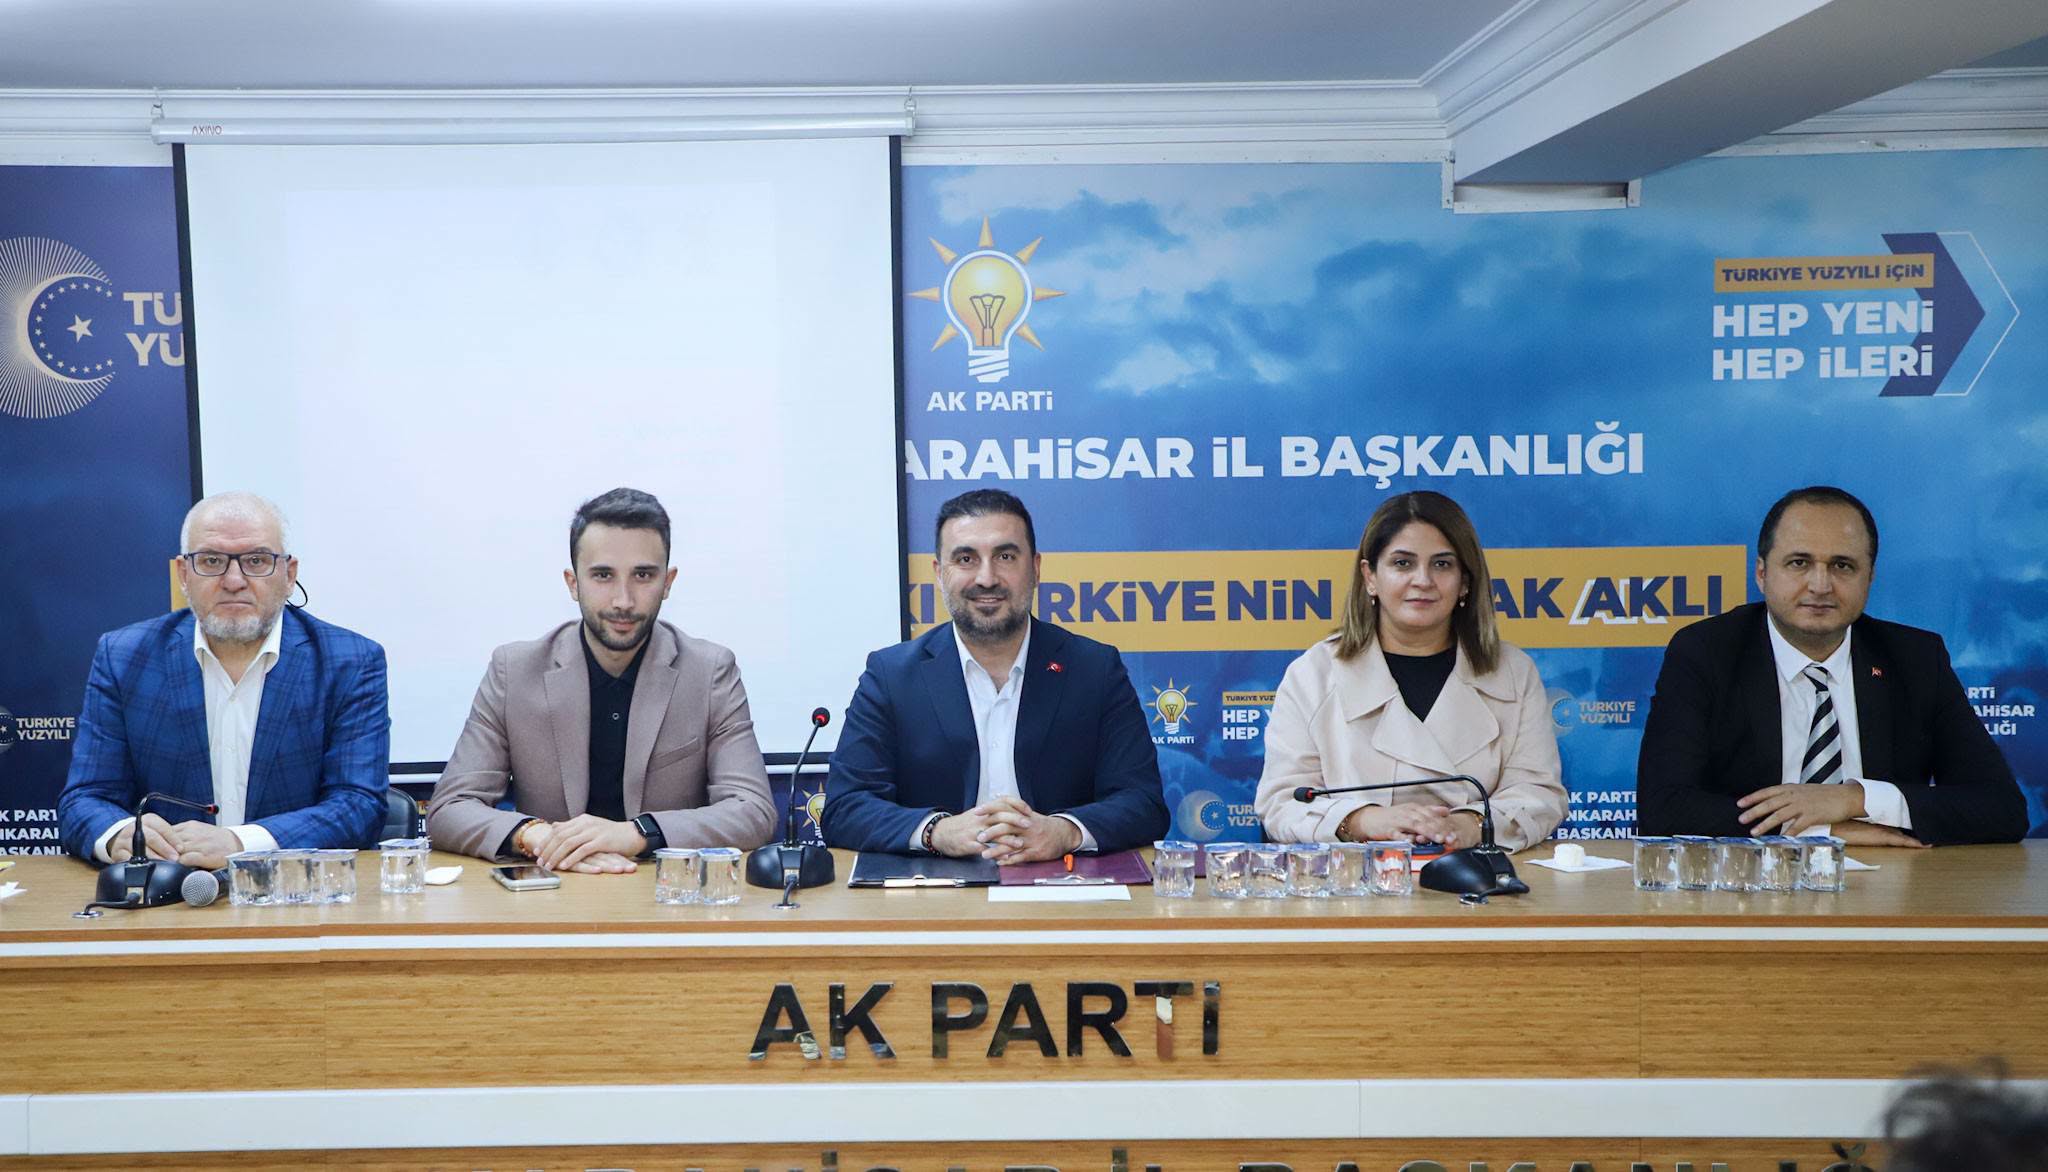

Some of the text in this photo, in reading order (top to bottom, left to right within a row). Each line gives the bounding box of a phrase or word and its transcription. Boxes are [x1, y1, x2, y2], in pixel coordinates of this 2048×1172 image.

[1713, 303, 1809, 338] HEP
[1713, 347, 1805, 381] HEP
[926, 391, 967, 412] AK
[1280, 421, 1644, 489] BAŞKANLIĞI
[1576, 575, 1722, 620] AKLI
[1222, 709, 1261, 723] HEP
[1222, 726, 1259, 740] HEP
[1151, 736, 1165, 744] AK
[748, 982, 897, 1060] AK
